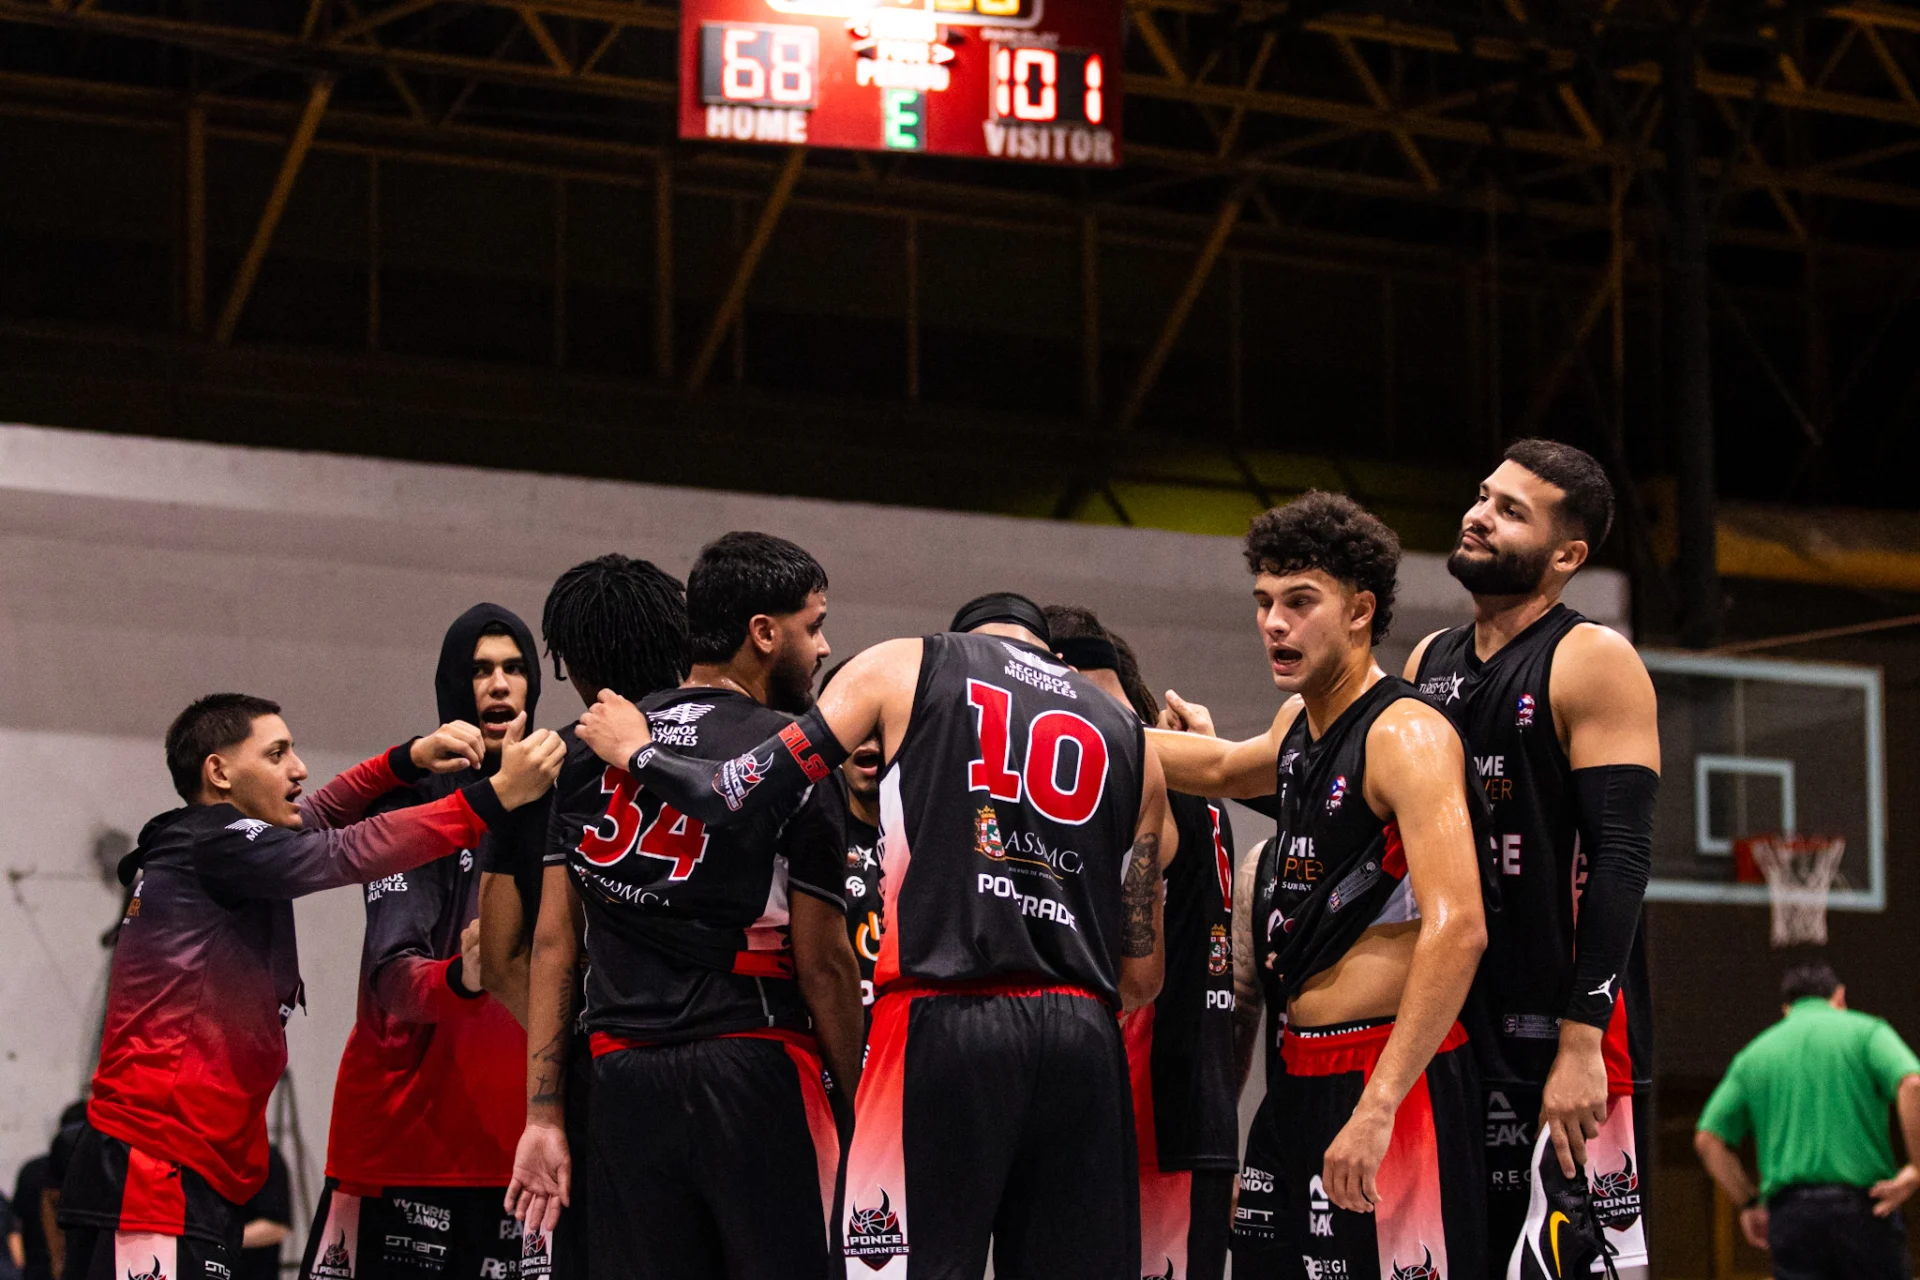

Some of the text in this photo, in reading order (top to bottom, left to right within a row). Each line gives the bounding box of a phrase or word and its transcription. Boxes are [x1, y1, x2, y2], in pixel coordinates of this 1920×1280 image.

[722, 28, 813, 102] 68
[705, 106, 807, 143] HOME
[983, 121, 1114, 163] VISITOR
[1004, 665, 1078, 699] MULTIPLES
[1008, 659, 1071, 690] SEGUROS
[966, 678, 1110, 825] 10
[574, 766, 710, 882] 34
[843, 1246, 910, 1256] VEJIGANTES
[849, 1234, 902, 1246] PONCE
